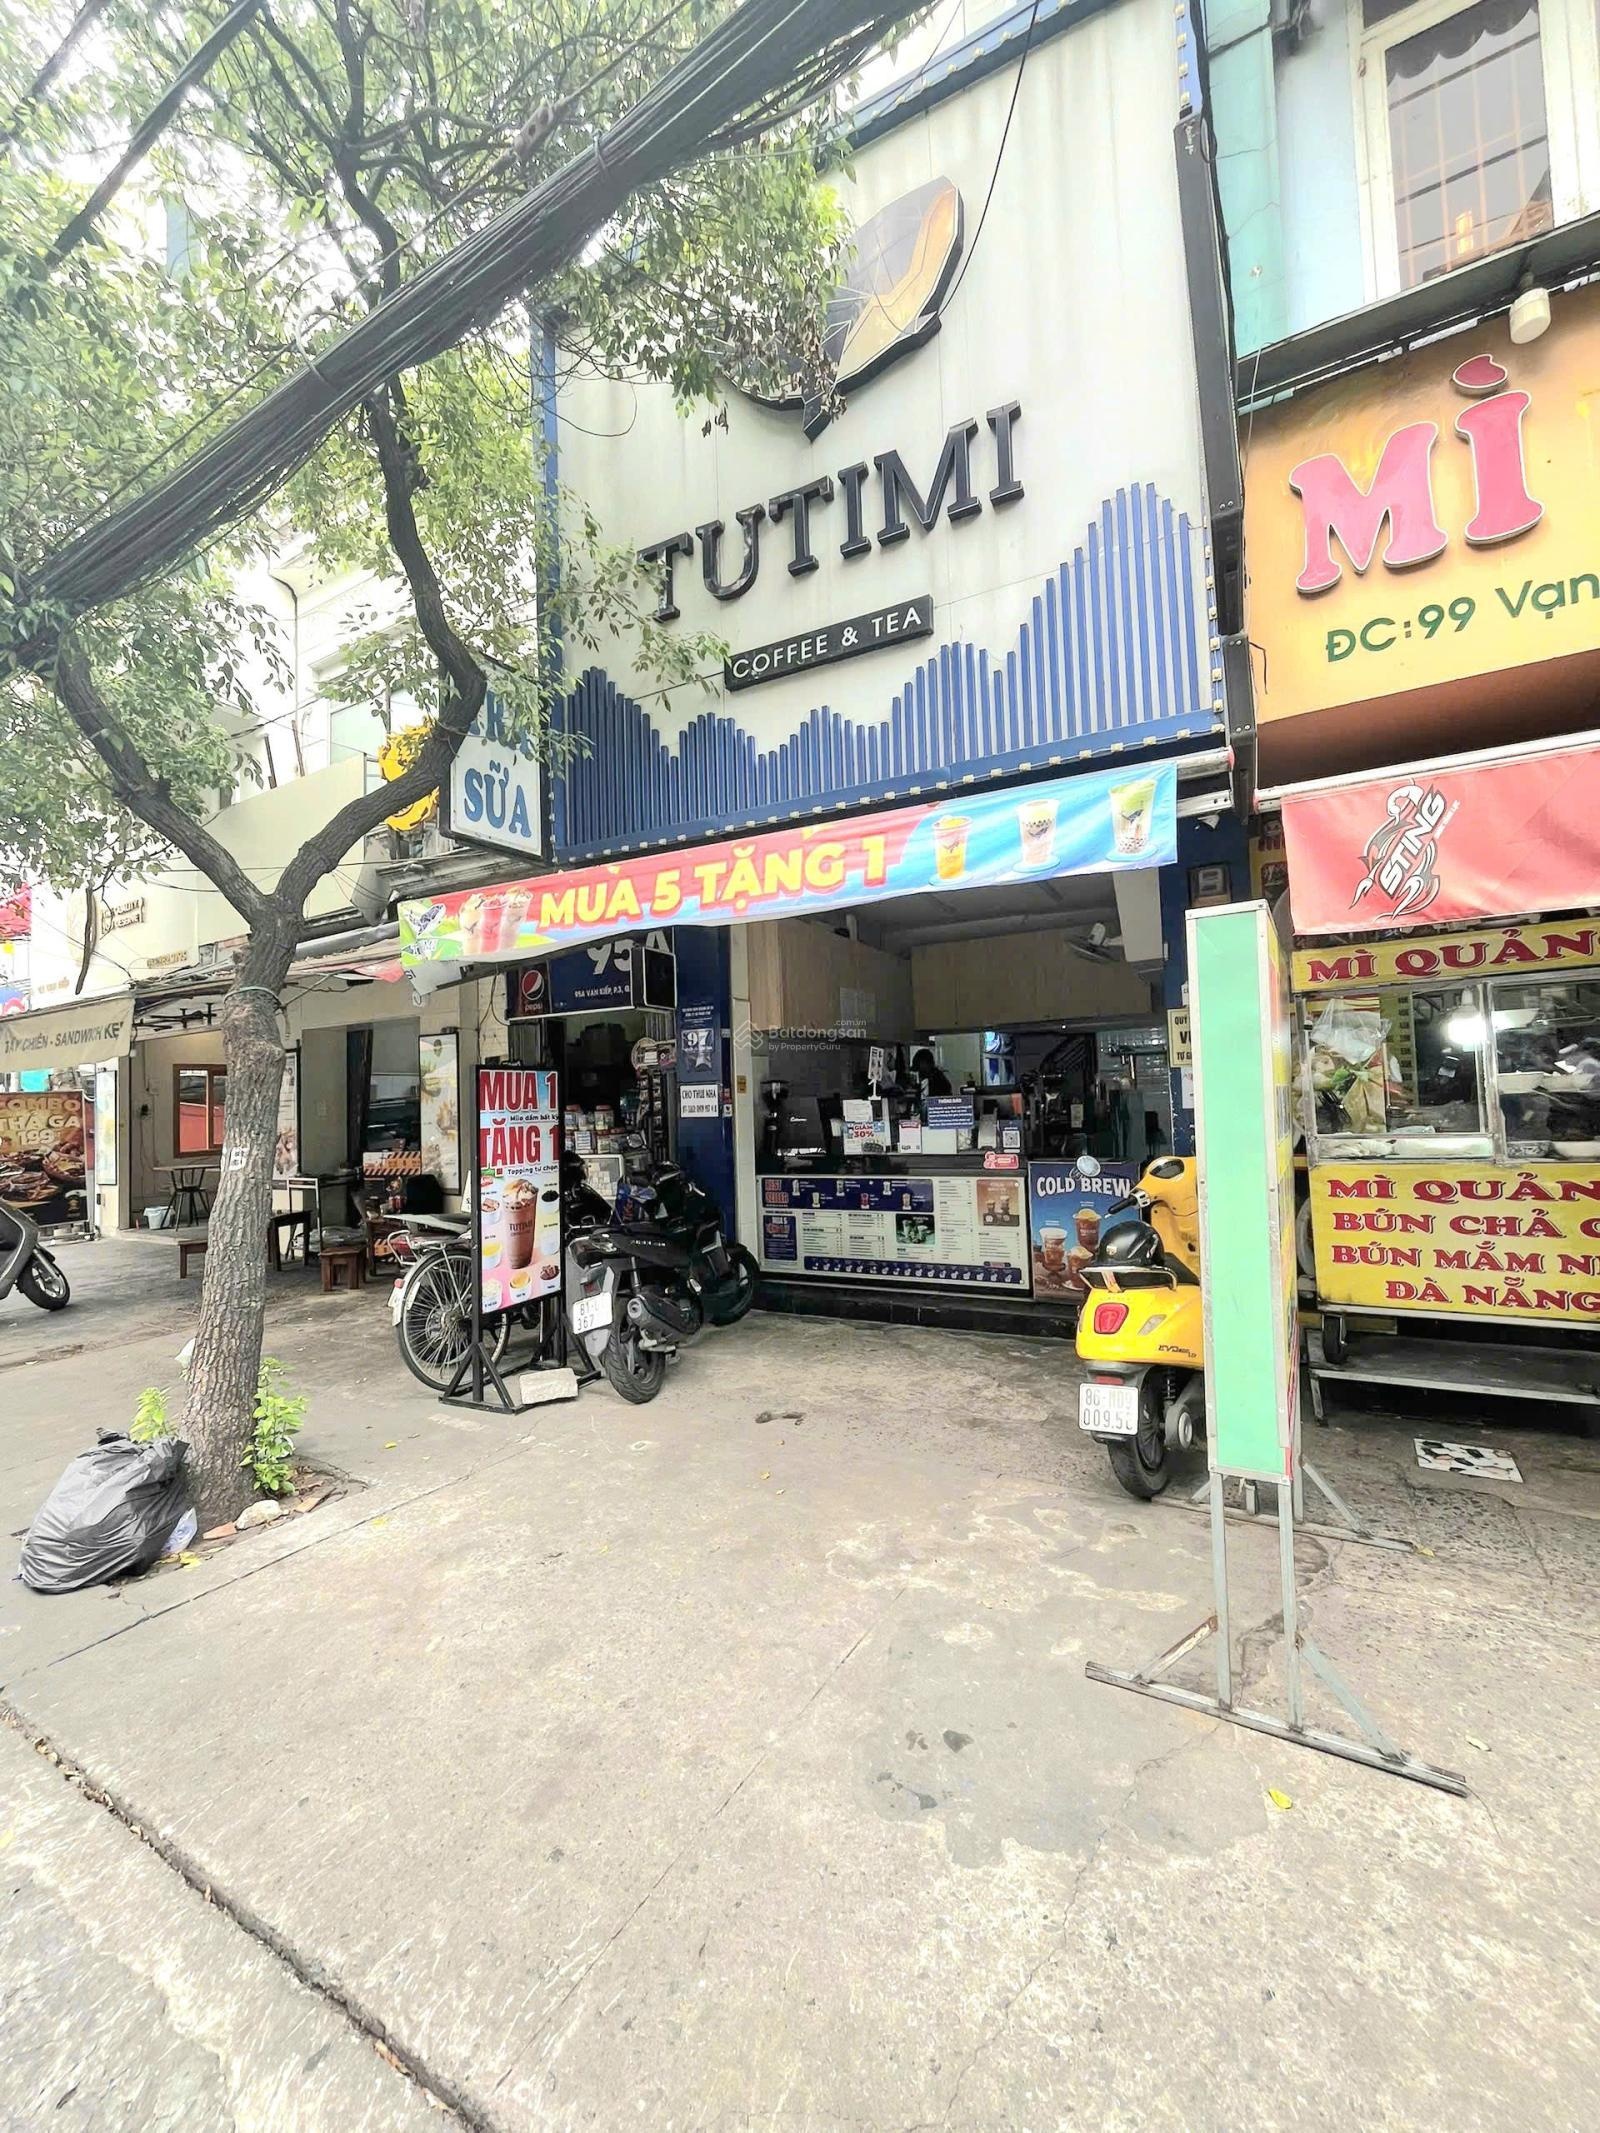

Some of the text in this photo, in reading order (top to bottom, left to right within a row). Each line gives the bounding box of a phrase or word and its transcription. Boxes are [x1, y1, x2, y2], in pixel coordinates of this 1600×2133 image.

[637, 400, 1024, 624] TUTIMI
[733, 606, 922, 679] COFFEE & TEA
[1325, 573, 1600, 663] ĐC:99 Vạn
[464, 760, 532, 839] SỮA
[1378, 785, 1448, 899] STING
[650, 871, 680, 912] 5
[694, 842, 845, 910] TẶNG
[861, 834, 886, 880] 1
[1308, 928, 1600, 983] MÌ QUẢN
[480, 1071, 557, 1111] MUA 1
[480, 1118, 560, 1175] TẶNG 1
[1036, 1176, 1131, 1199] COLD BREW
[1327, 1174, 1397, 1199] MÌ
[1332, 1208, 1435, 1234] BÚN
[1449, 1208, 1566, 1239] CHẢ
[1332, 1240, 1600, 1276] BÚN MẮM N
[1385, 1276, 1600, 1314] ĐÀ NẴNG
